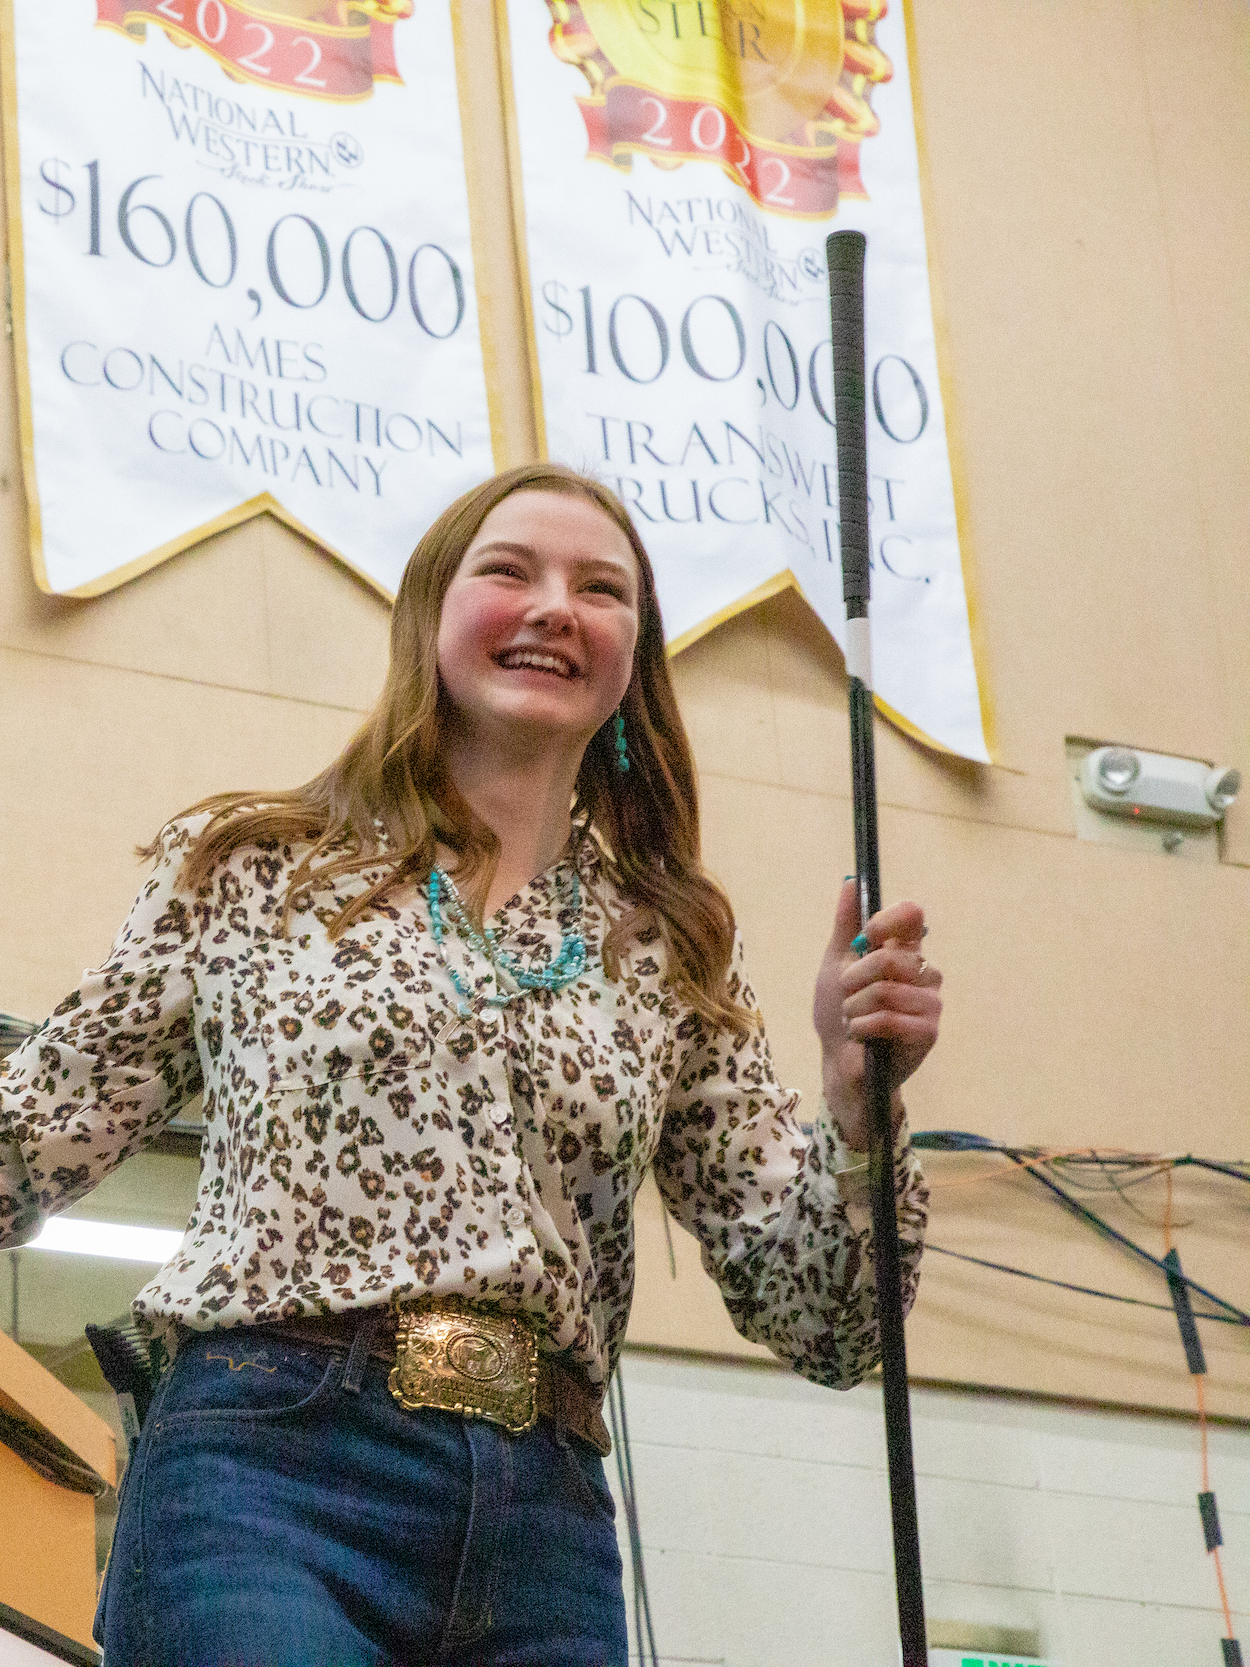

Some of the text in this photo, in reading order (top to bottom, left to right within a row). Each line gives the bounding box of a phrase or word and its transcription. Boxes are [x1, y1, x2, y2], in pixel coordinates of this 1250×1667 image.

[638, 0, 769, 62] STER
[137, 59, 308, 139] NATIONAL
[163, 104, 331, 176] WESTERN
[37, 157, 466, 340] $160,000
[204, 321, 328, 383] AMES
[59, 340, 464, 459] CONSTRUCTION
[148, 409, 388, 497] COMPANY
[584, 411, 906, 522] TRANSWET
[607, 474, 818, 560] RUCKS,
